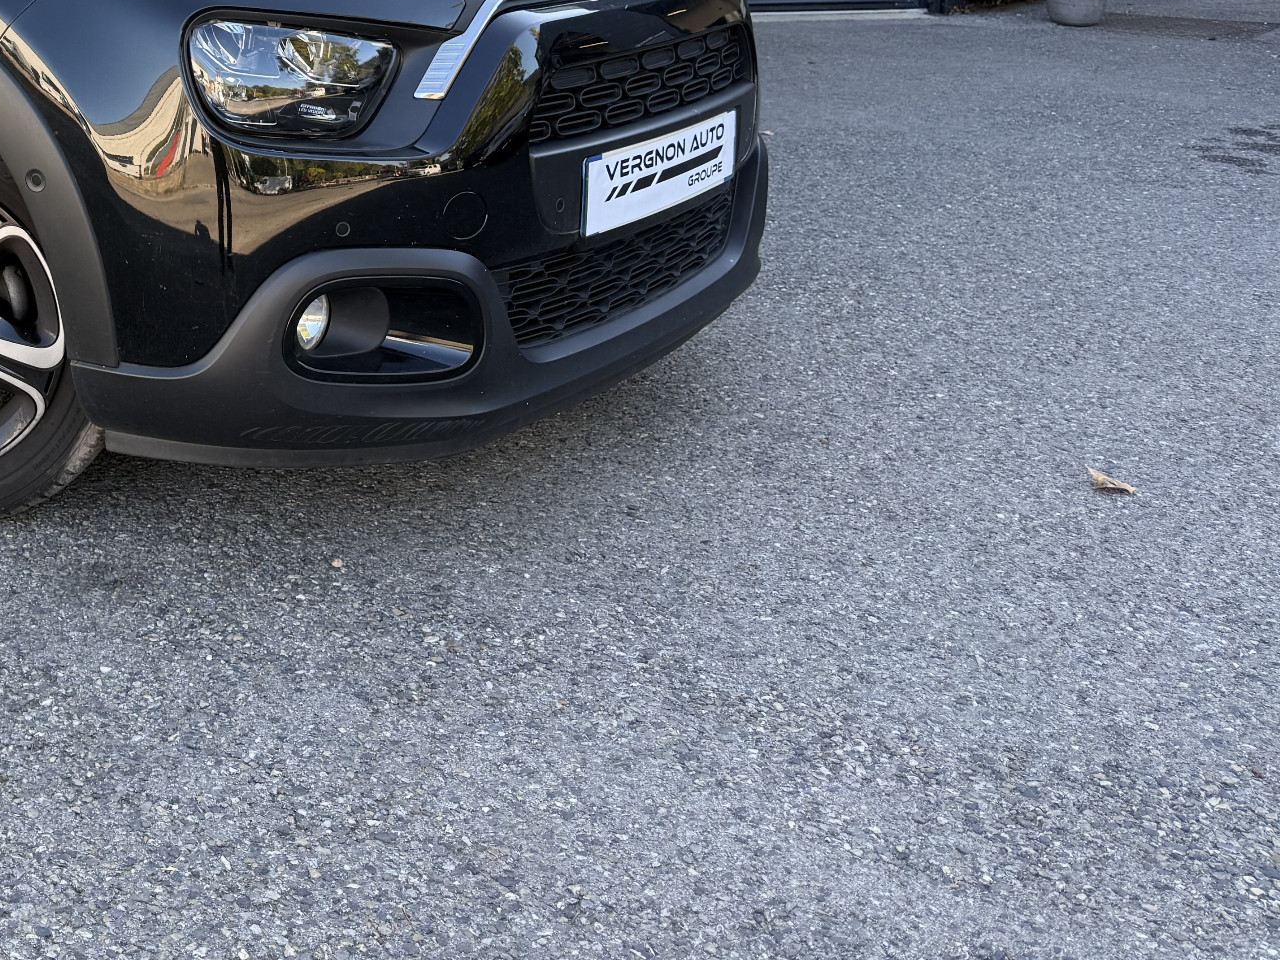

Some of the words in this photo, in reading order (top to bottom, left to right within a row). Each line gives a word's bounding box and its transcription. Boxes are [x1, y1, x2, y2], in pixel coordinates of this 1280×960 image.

[605, 137, 686, 181] VERGNON
[689, 123, 725, 153] AUTO
[687, 161, 723, 187] GROUPE
